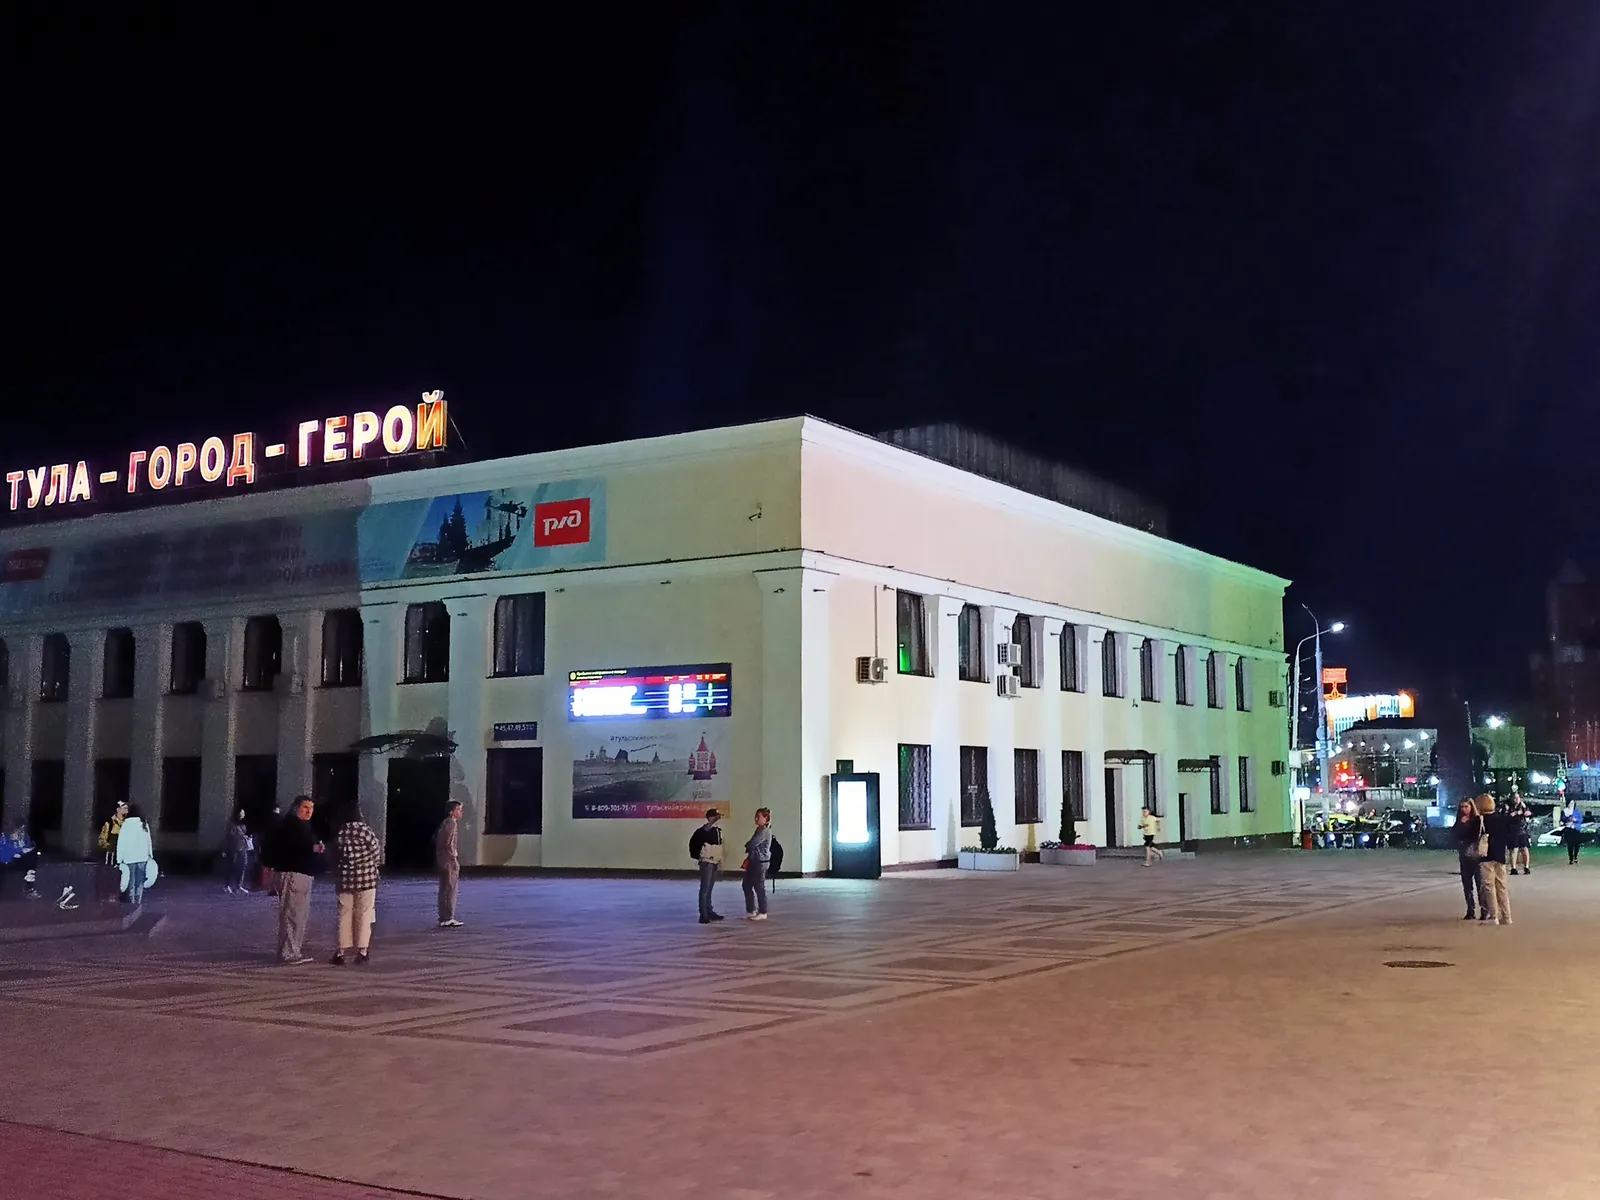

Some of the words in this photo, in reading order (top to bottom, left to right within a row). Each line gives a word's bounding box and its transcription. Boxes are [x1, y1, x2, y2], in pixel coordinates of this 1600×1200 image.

[6, 460, 91, 511] ТУЛА
[127, 432, 255, 494] ГОРОД
[298, 389, 446, 467] ГЕРОЙ
